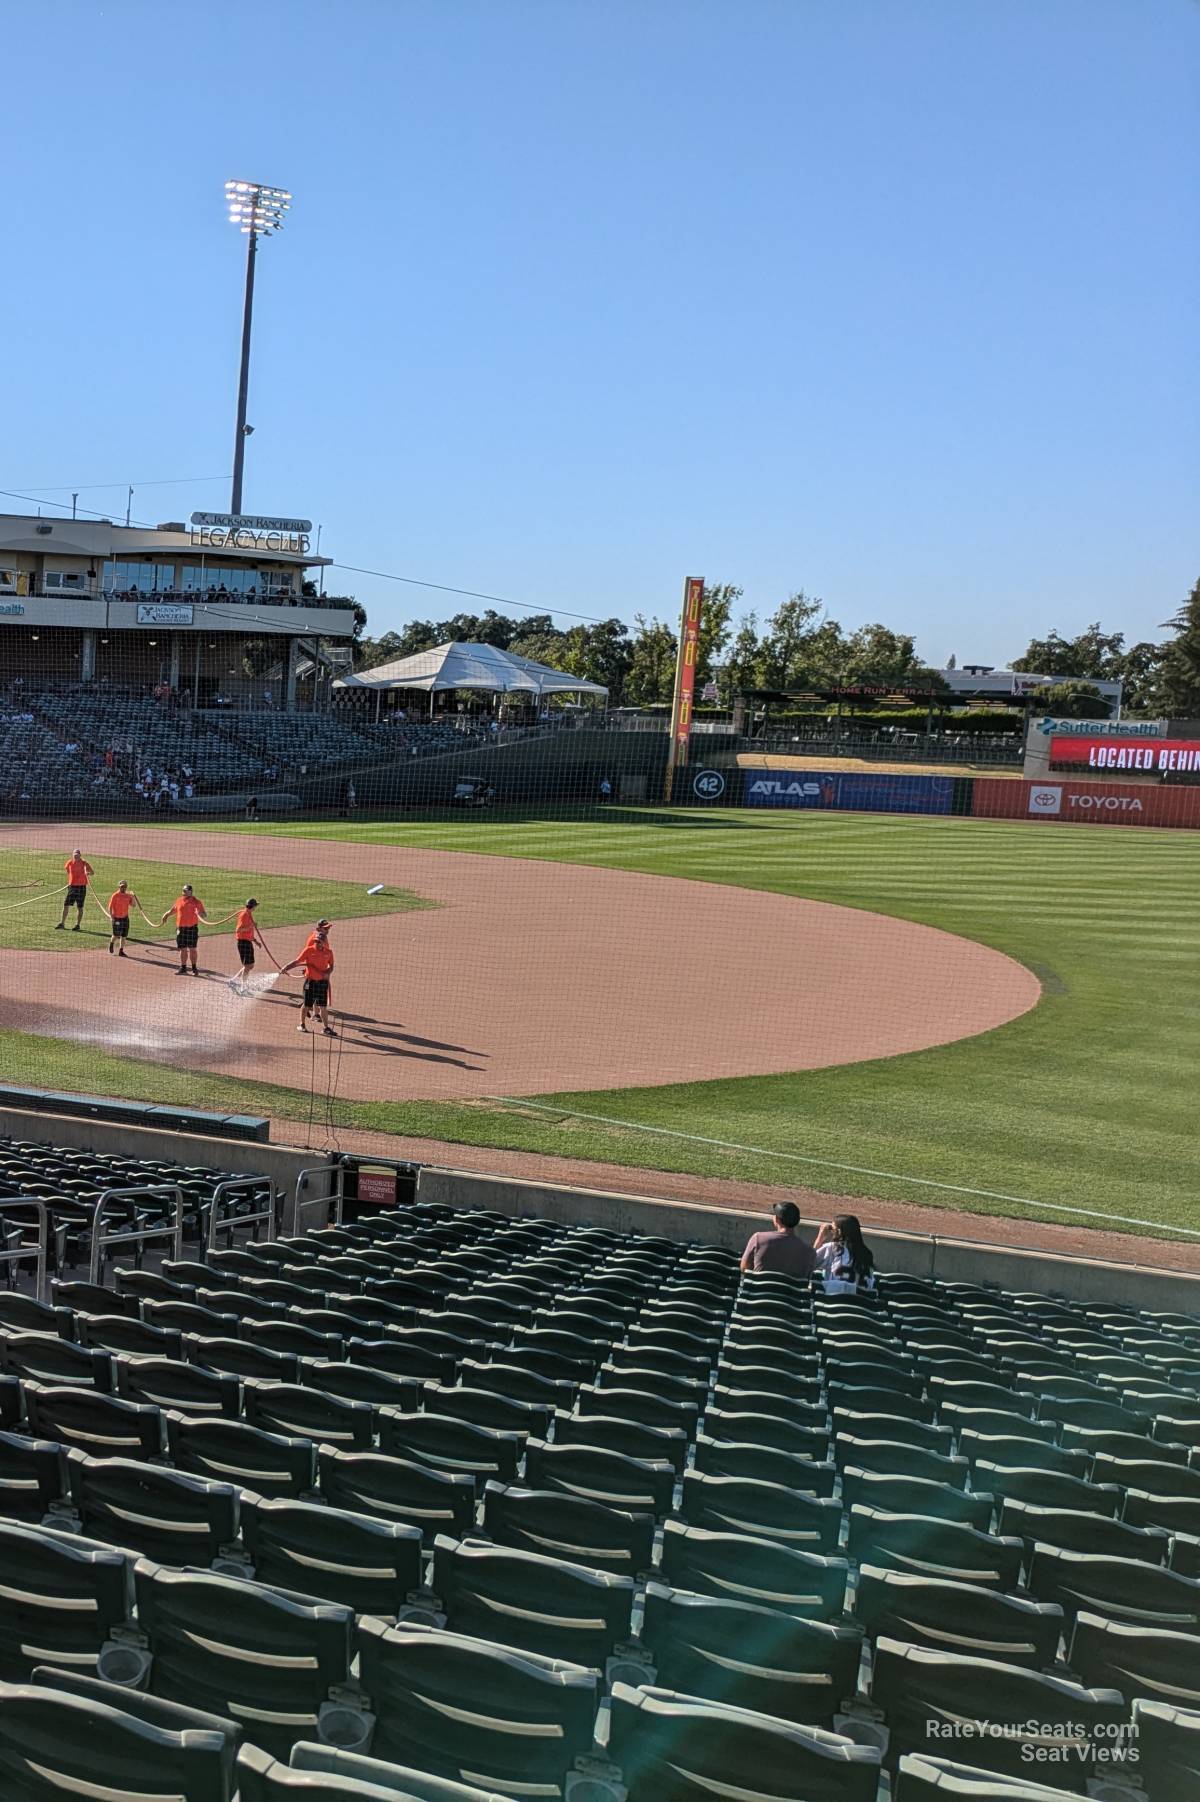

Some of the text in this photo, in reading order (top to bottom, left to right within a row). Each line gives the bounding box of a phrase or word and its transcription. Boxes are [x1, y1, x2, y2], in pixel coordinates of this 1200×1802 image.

[190, 526, 310, 553] LEGACY CLUB
[831, 686, 937, 696] HOME RUN TERRACE
[1058, 721, 1159, 736] Sutter Health
[1089, 746, 1154, 769] LOCATED
[698, 778, 718, 792] 42
[750, 780, 820, 797] ATLAS
[1068, 795, 1143, 811] TOYOTA
